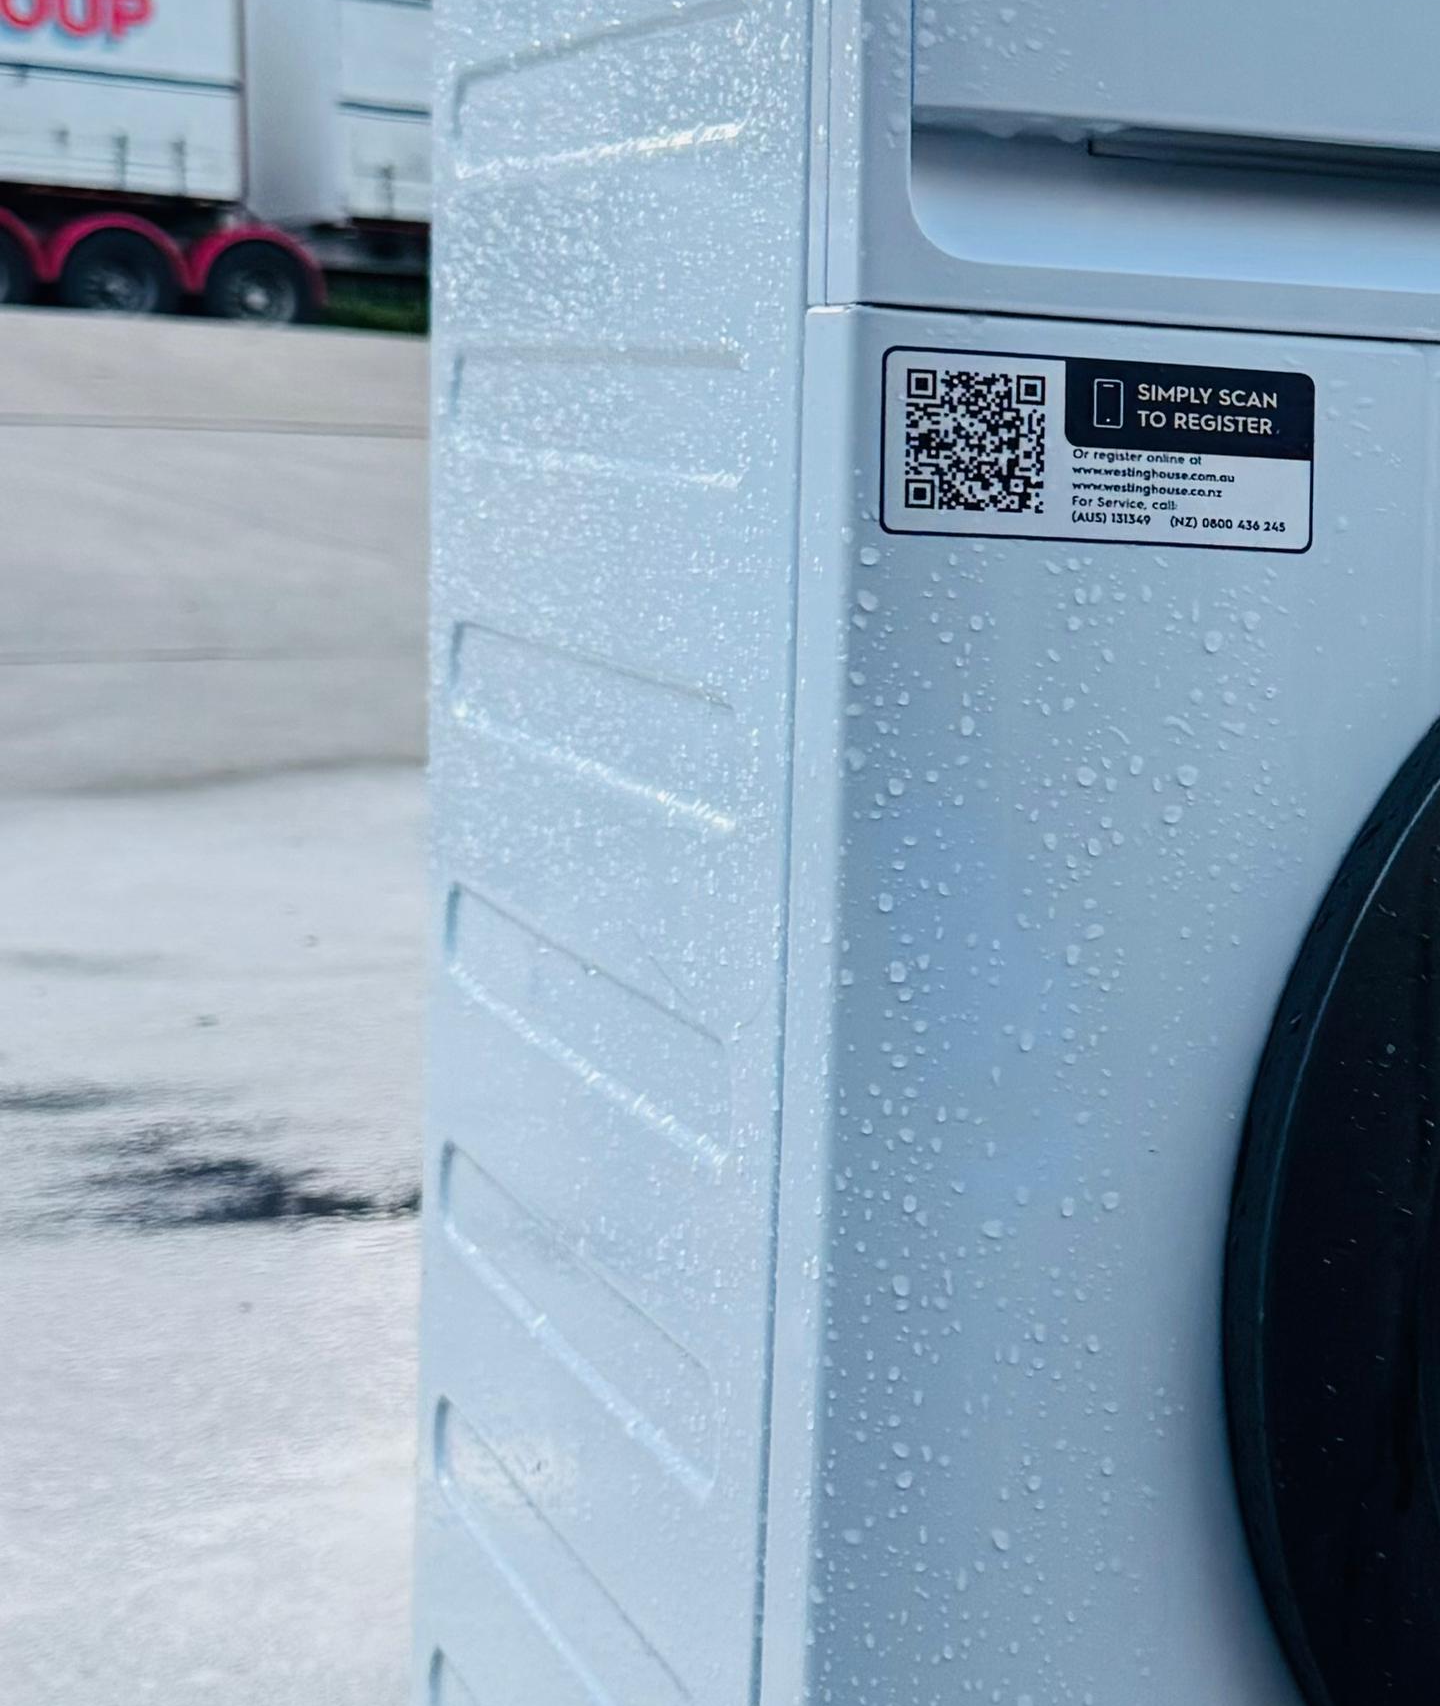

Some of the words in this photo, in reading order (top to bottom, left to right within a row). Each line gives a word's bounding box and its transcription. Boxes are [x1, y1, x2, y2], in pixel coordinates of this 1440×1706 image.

[1137, 383, 1214, 407] SIMPLY
[1218, 389, 1278, 410] SCAN
[1137, 410, 1167, 429] TO
[1173, 412, 1273, 436] REGISTER
[1072, 447, 1089, 460] Or
[1093, 449, 1143, 464] register
[1146, 452, 1185, 466] online
[1189, 454, 1202, 466] at
[1071, 465, 1236, 484] www.westinghouse.com.au
[1071, 480, 1223, 499] www.westinghouse.co.nz
[1071, 495, 1093, 508] For
[1097, 496, 1148, 511] Service,
[1071, 510, 1107, 525] (AUS)
[1169, 515, 1199, 529] (NZ)
[1202, 517, 1233, 530] 0800
[1237, 519, 1260, 532] 436
[1263, 520, 1286, 533] 245
